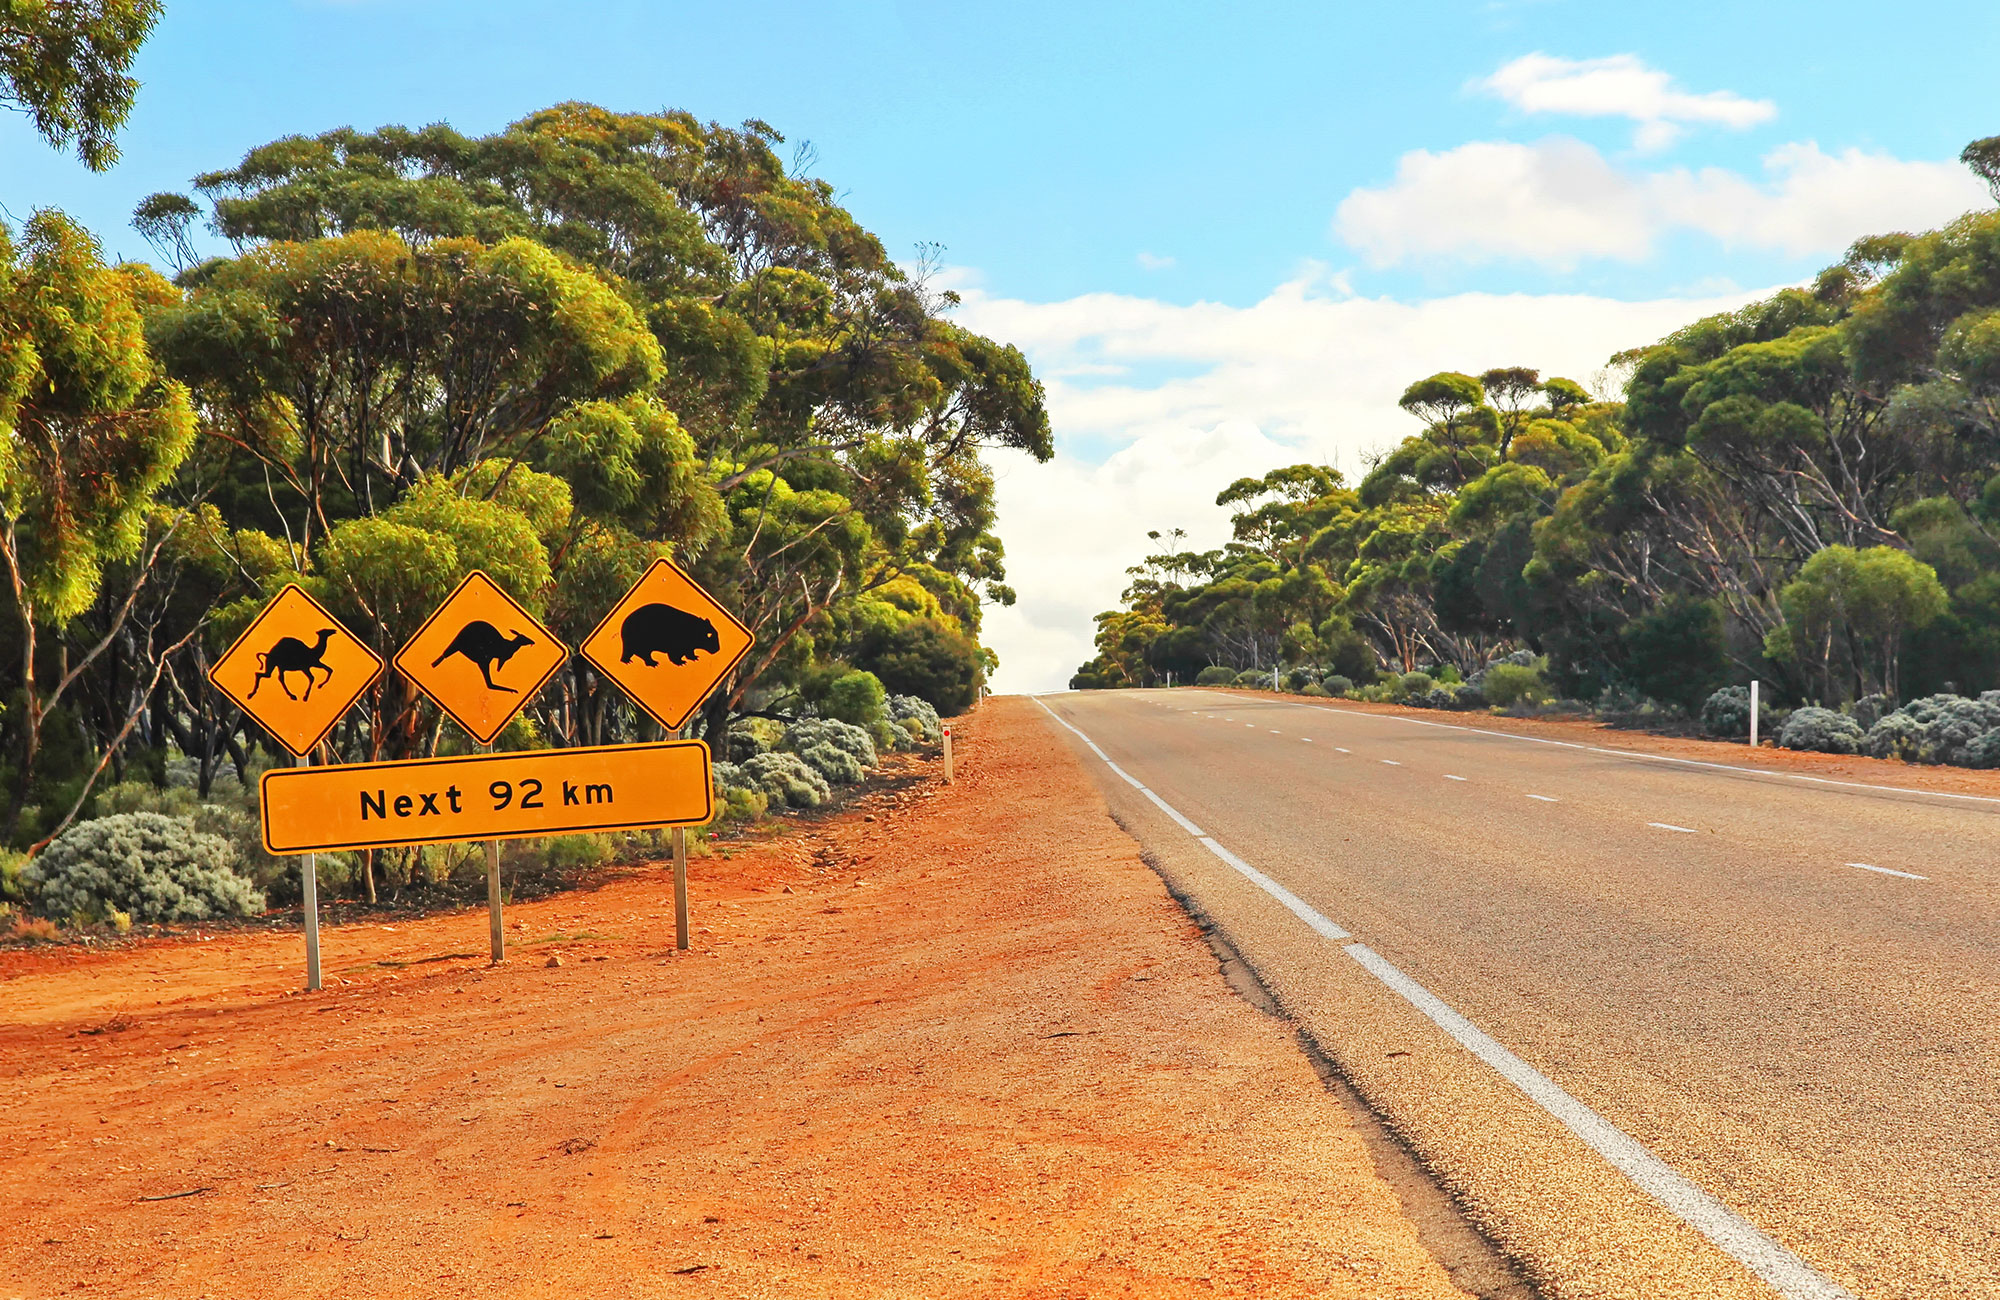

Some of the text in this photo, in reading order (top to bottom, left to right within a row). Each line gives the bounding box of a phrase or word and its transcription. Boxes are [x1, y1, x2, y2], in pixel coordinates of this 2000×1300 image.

[359, 779, 614, 820] Next 92 km
